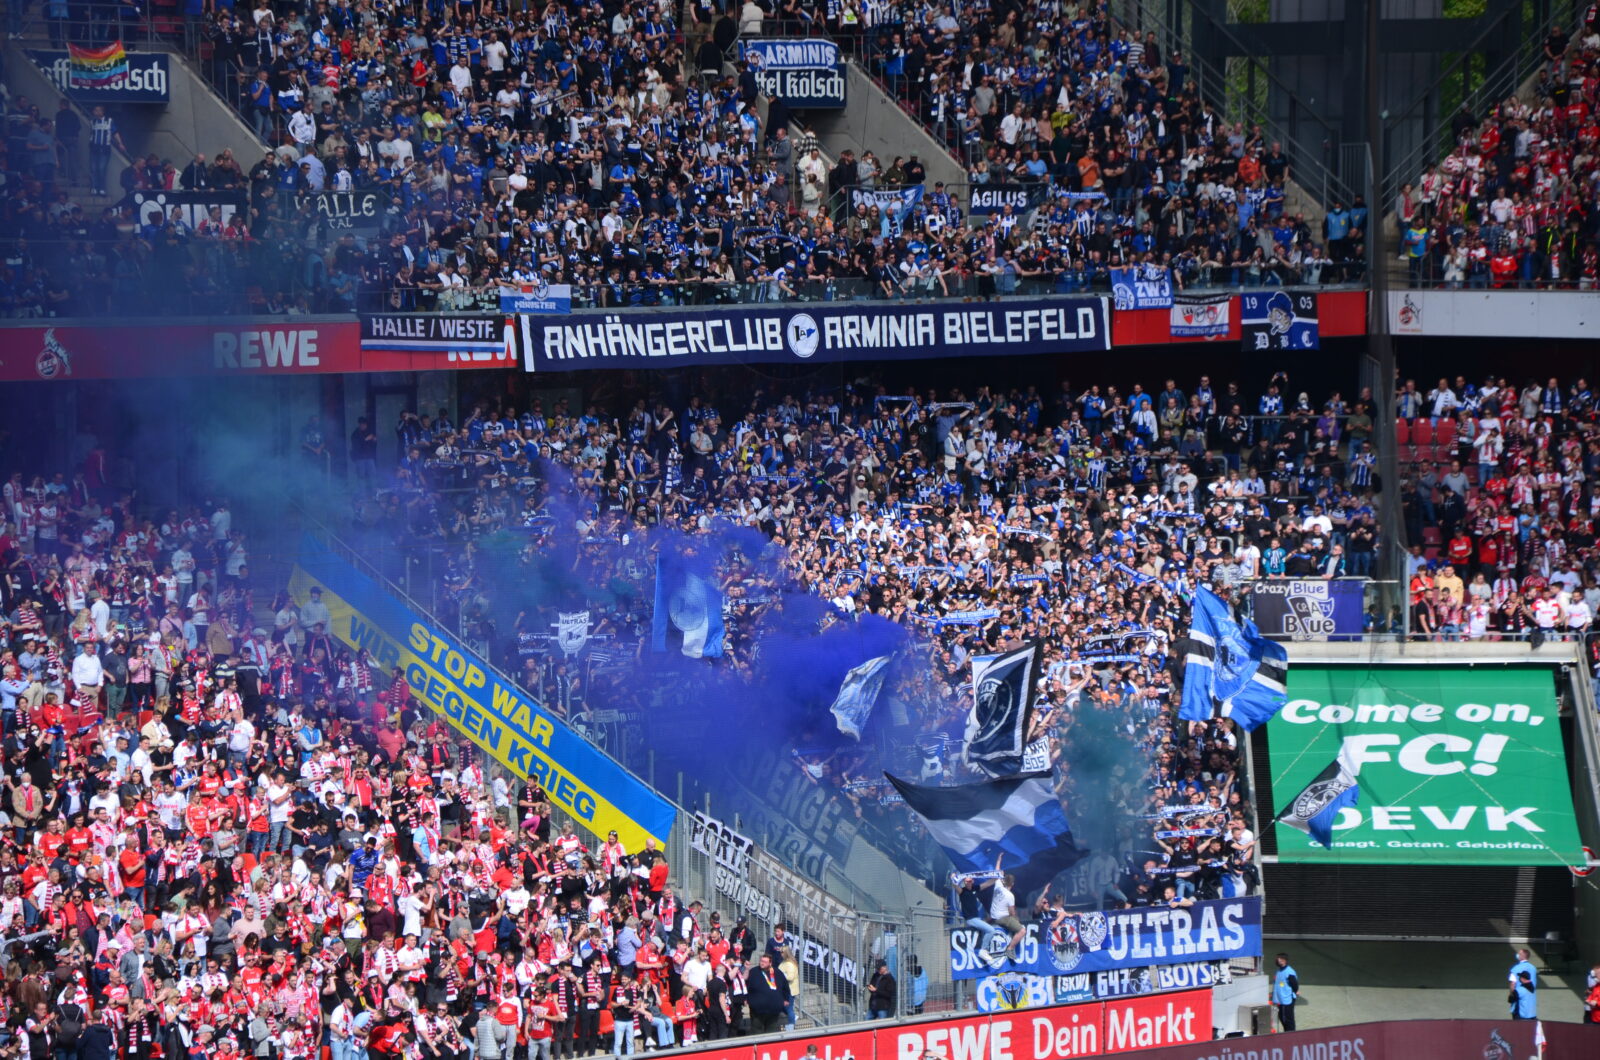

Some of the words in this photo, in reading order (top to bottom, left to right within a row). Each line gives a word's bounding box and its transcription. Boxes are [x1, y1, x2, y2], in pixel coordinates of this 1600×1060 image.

[1245, 296, 1258, 310] 19
[1299, 296, 1313, 310] 05
[371, 317, 426, 338] HALLE
[440, 319, 496, 339] WESTF.
[543, 316, 784, 360] ANHÄNGERCLUB
[824, 313, 936, 350] ARMINIA
[944, 306, 1096, 346] BIELEFELD
[214, 330, 320, 369] REWE
[1255, 583, 1290, 597] Crazy
[1293, 583, 1325, 594] Blue
[349, 615, 401, 667] WIR
[408, 622, 486, 690] STOP
[491, 685, 554, 749] WAR
[1281, 699, 1444, 725] Come
[1456, 703, 1545, 726] on,
[405, 663, 501, 750] GEGEN
[508, 739, 596, 822] KRIEG
[1341, 733, 1510, 777] FC!
[1309, 840, 1381, 850] Gsagt.
[1108, 903, 1245, 960] ULTRAS
[1097, 968, 1130, 996] 647
[898, 1020, 1013, 1060] REWE
[1033, 1014, 1097, 1060] Dein
[1107, 1003, 1196, 1050] Markt
